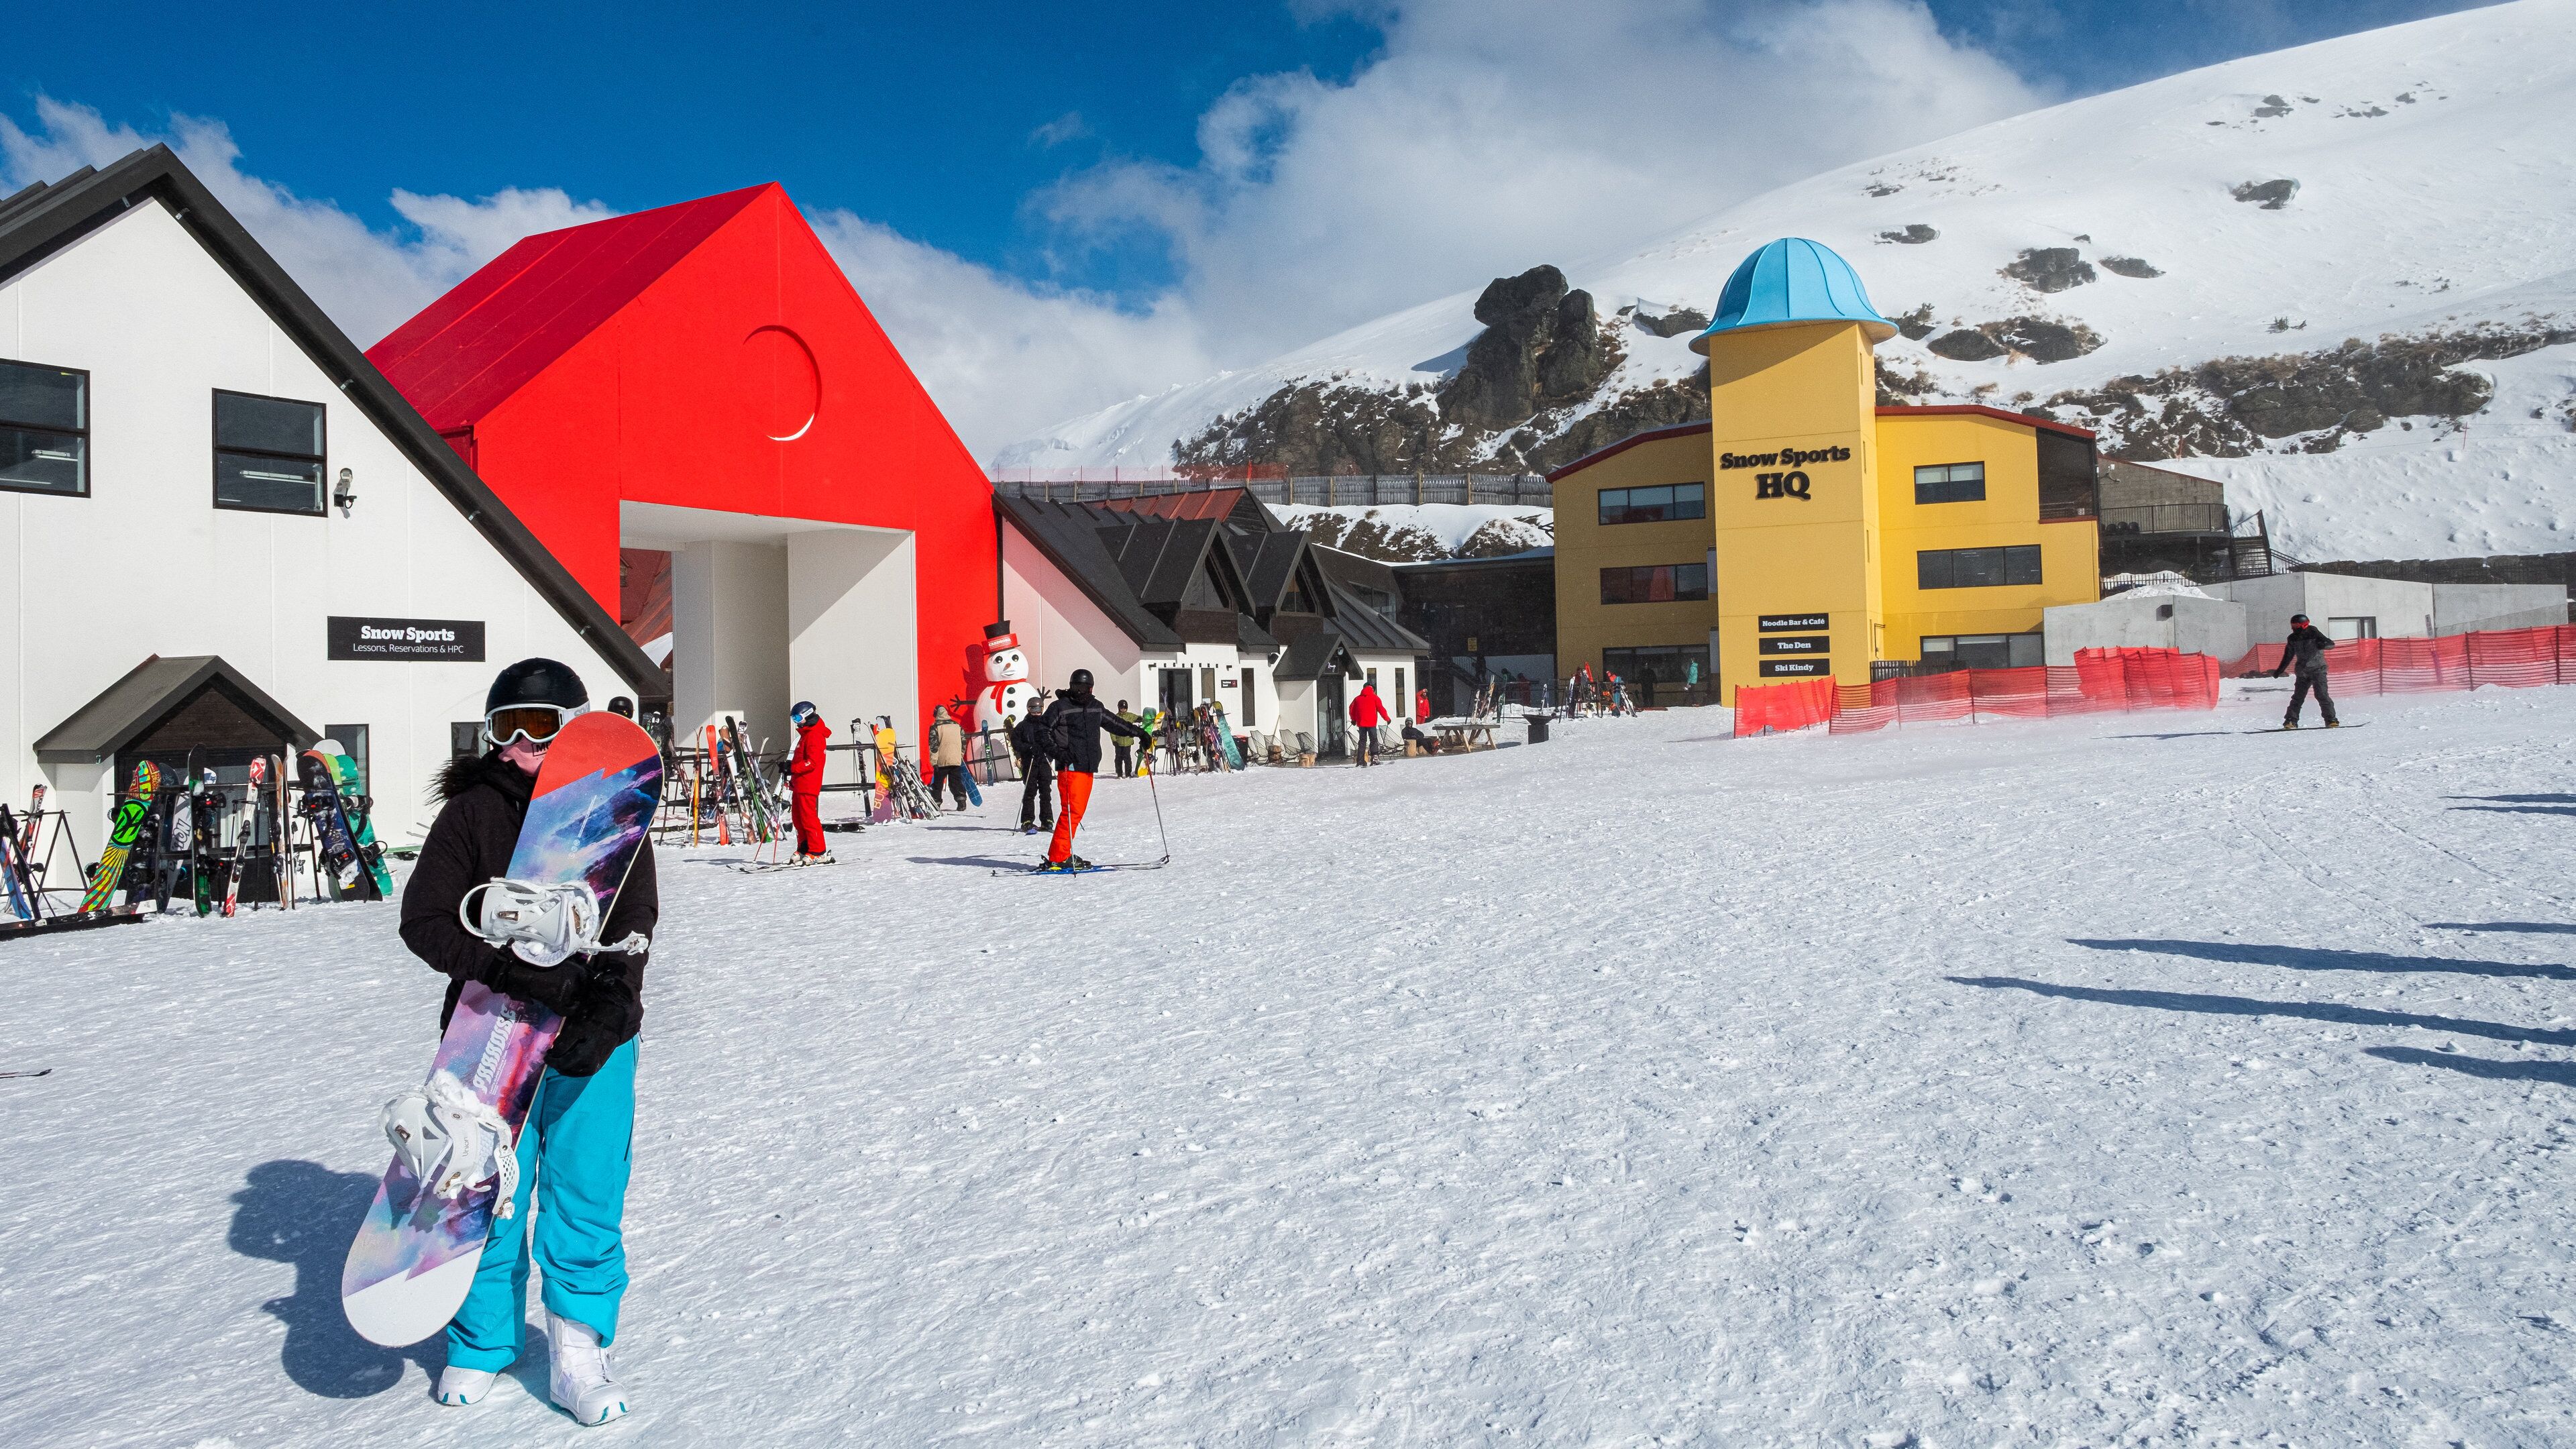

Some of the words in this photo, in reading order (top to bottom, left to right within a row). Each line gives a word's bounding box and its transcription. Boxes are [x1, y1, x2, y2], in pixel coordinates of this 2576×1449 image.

[1721, 452, 1778, 469] Snow
[1780, 445, 1851, 468] Sports
[1756, 471, 1811, 500] HQ
[361, 625, 405, 640] Snow
[406, 627, 455, 643] Sports
[353, 643, 387, 653] Lessons,
[389, 644, 438, 653] Reservations
[439, 645, 446, 653] &
[447, 645, 464, 653] HPC
[472, 1003, 516, 1095] PARADISE
